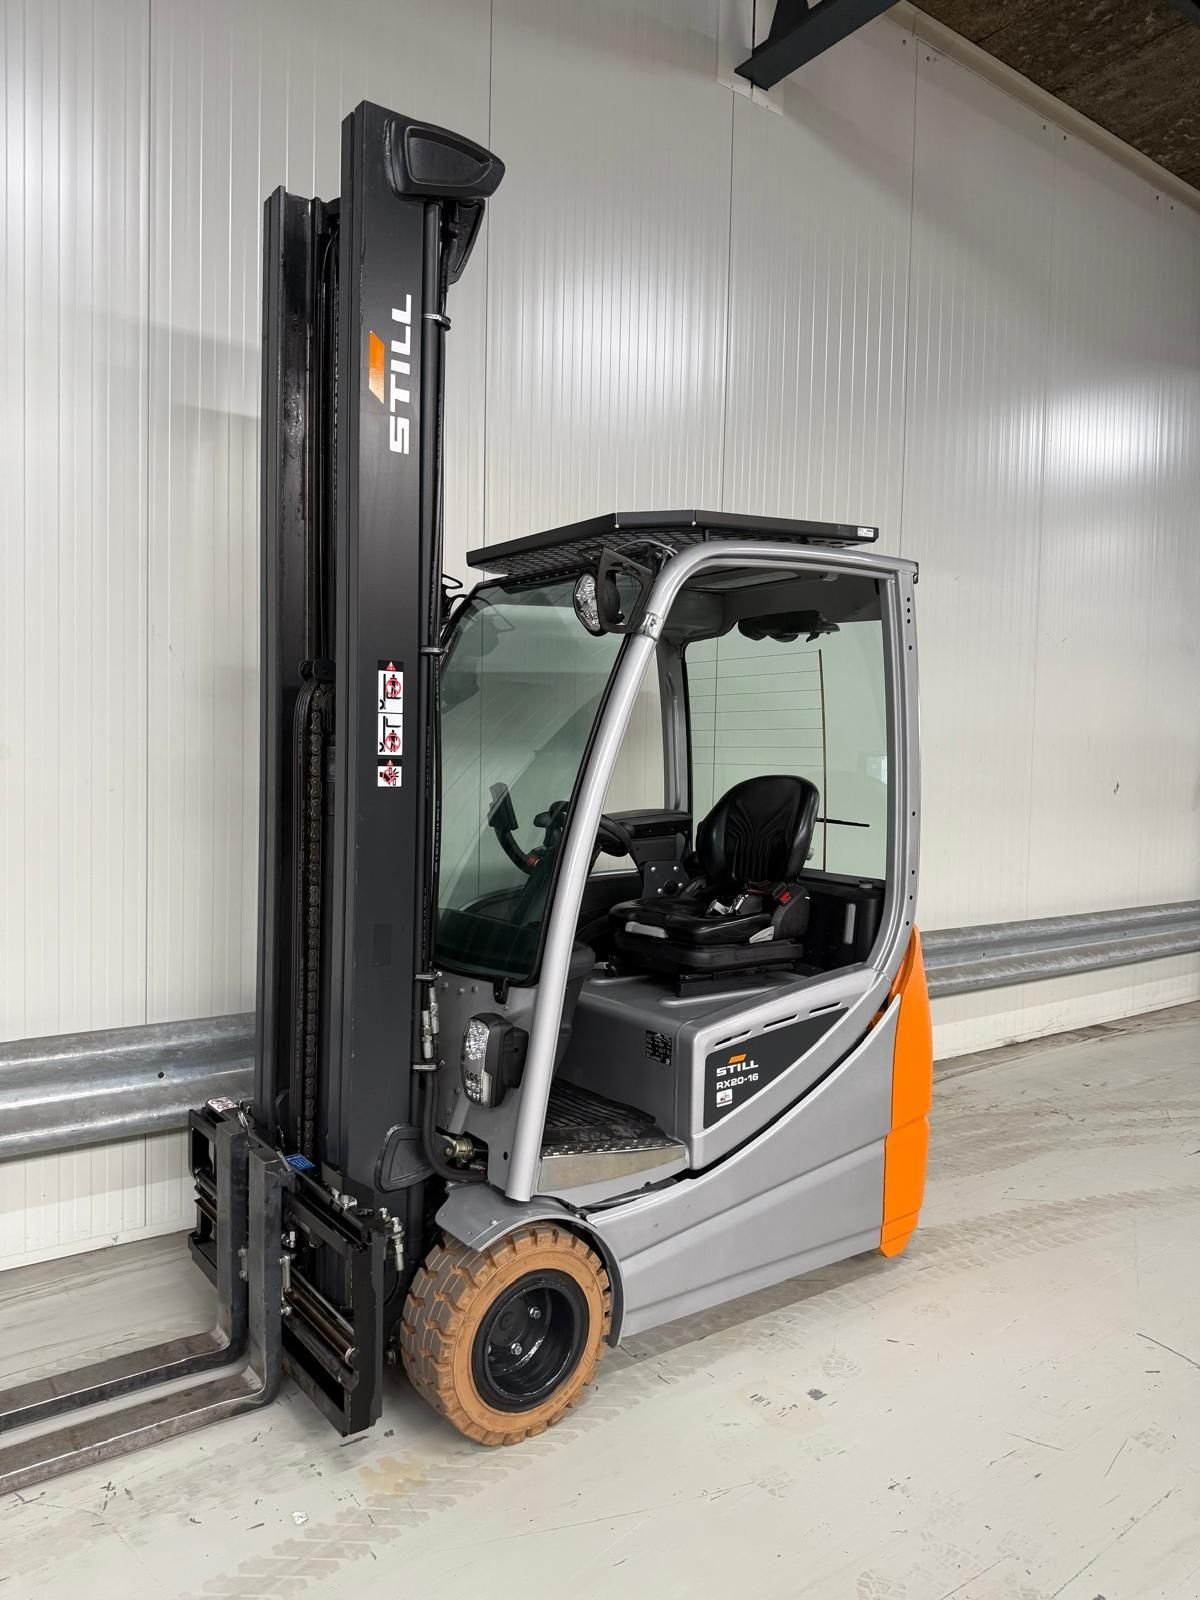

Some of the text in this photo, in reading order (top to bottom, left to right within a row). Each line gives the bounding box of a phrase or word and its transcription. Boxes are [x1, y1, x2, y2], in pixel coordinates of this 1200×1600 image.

[390, 294, 412, 455] STILL
[716, 1060, 759, 1077] STILL
[716, 1073, 759, 1090] RX20-16
